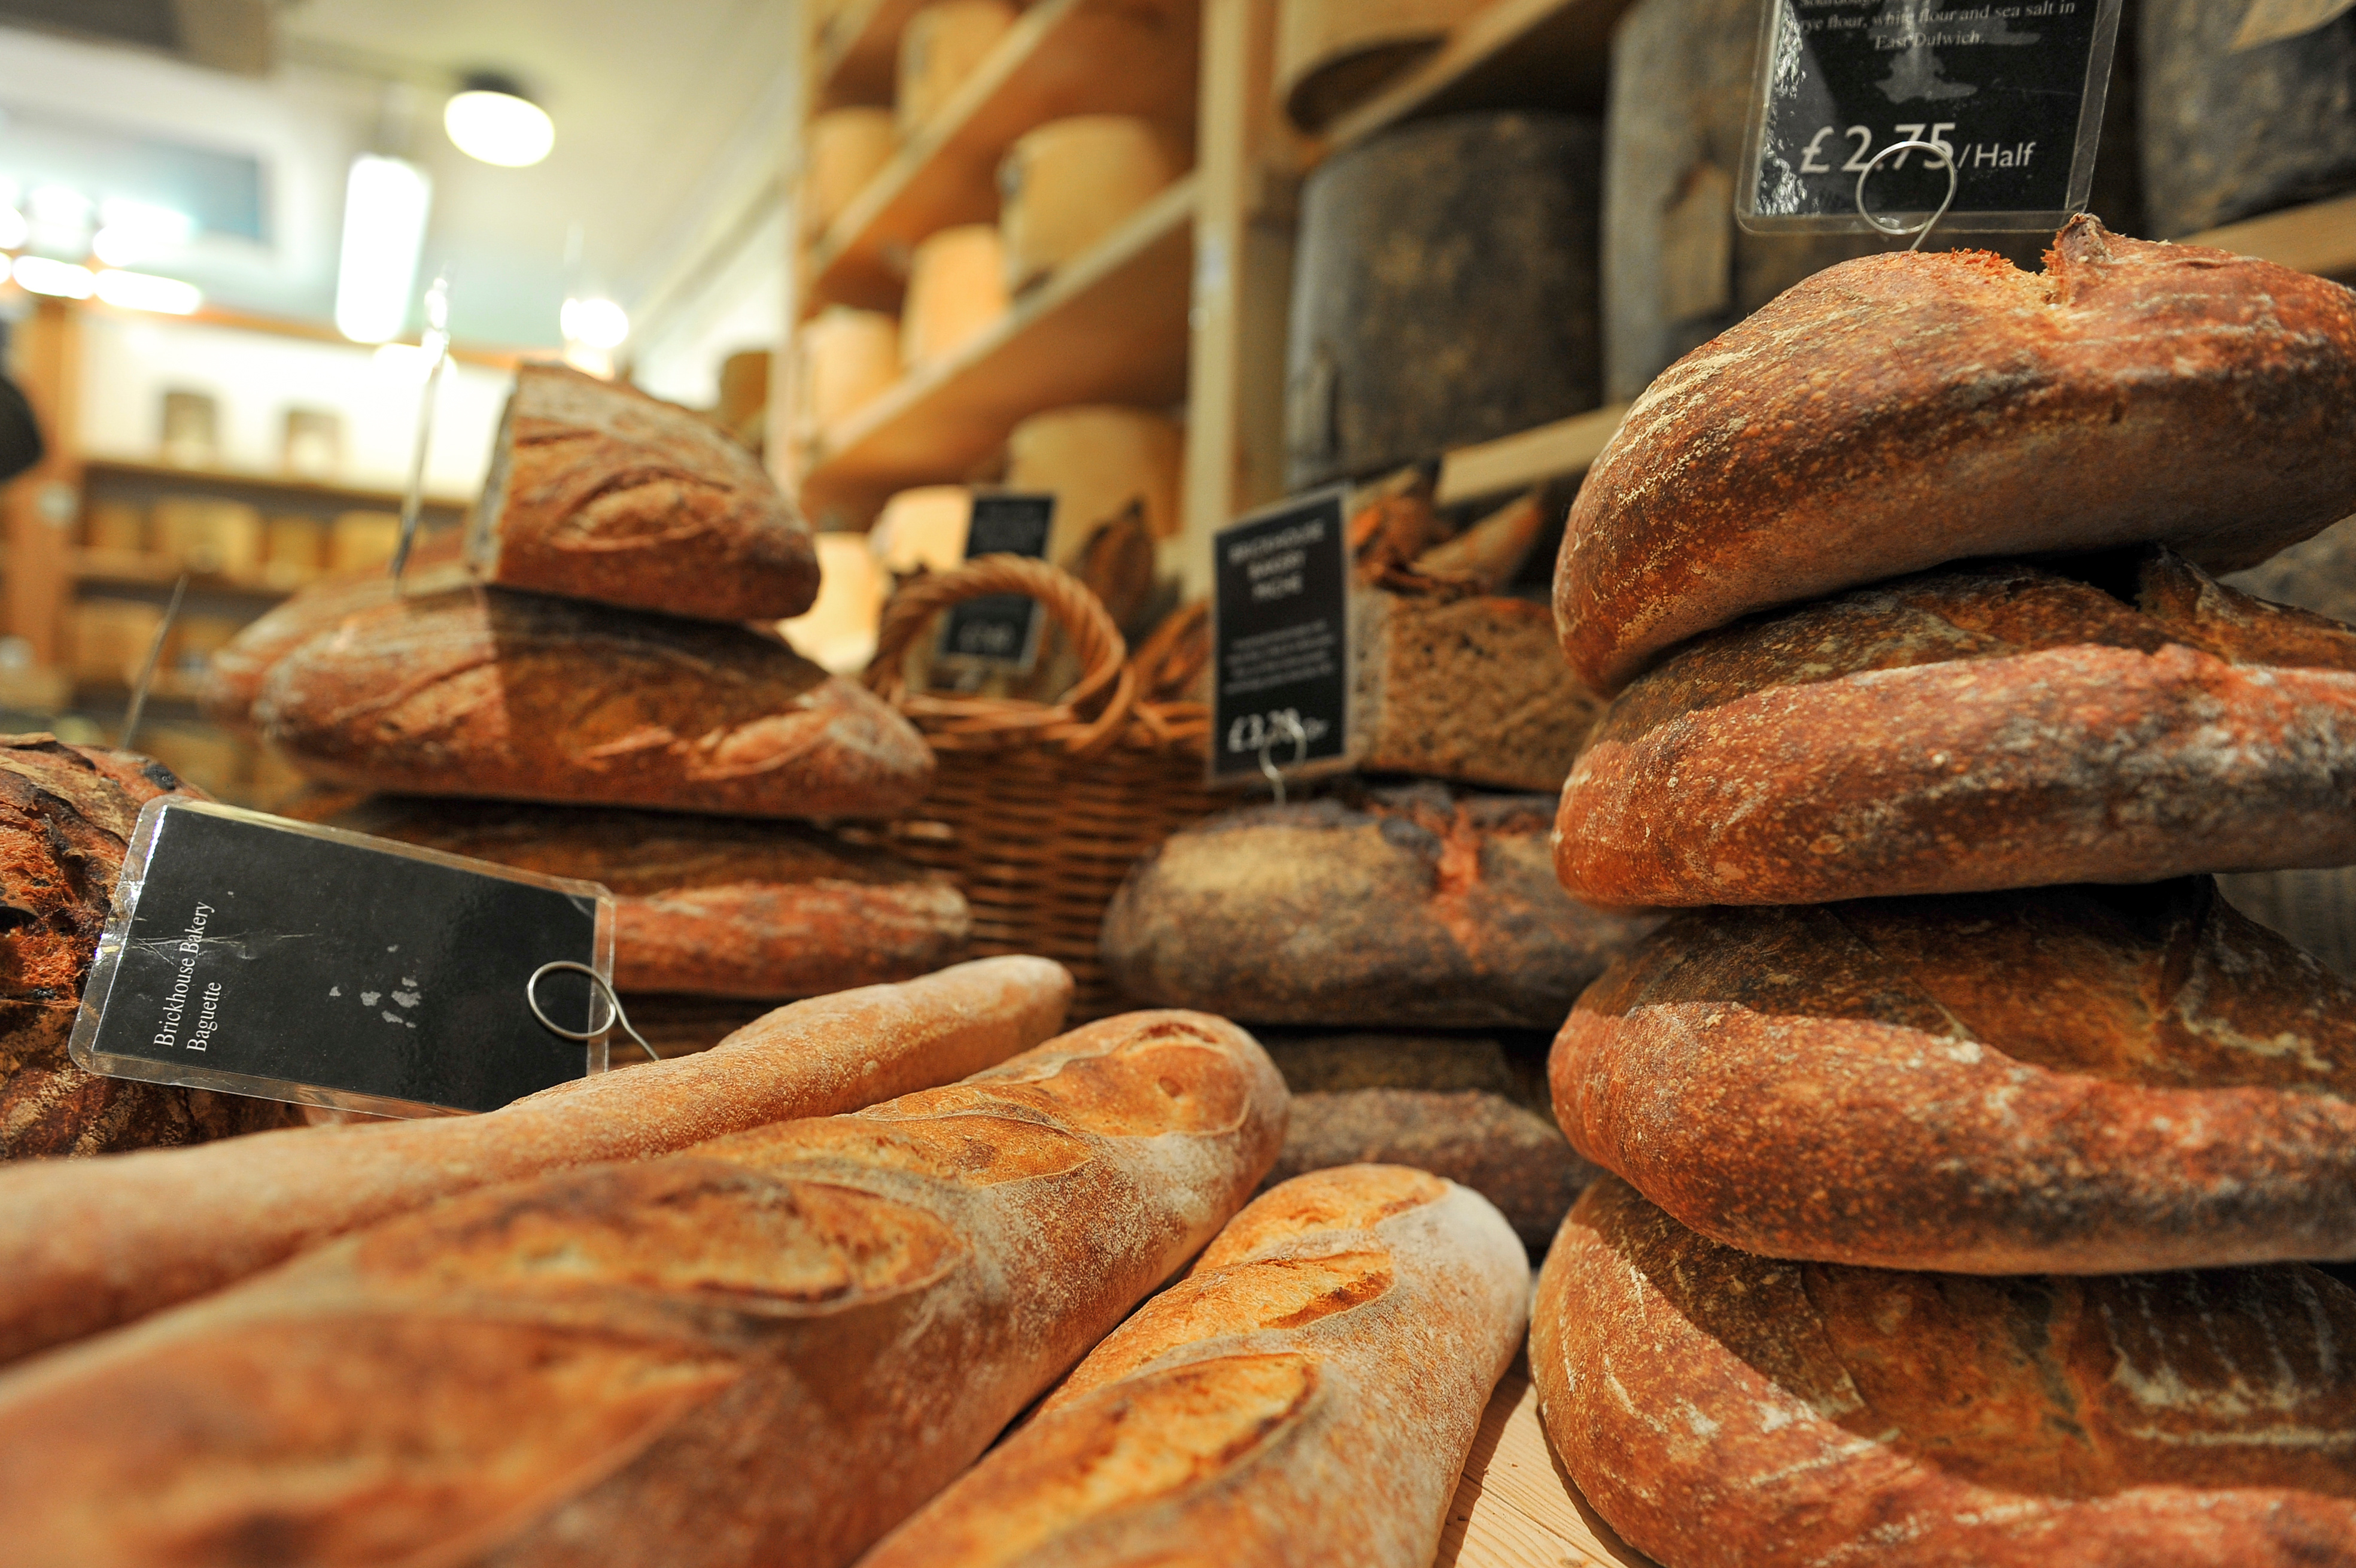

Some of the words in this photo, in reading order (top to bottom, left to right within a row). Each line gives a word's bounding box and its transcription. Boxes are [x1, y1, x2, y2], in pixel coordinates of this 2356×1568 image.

[1826, 14, 1868, 29] flour,
[1919, 8, 1957, 23] flour
[1960, 5, 1990, 21] and
[1995, 6, 2020, 18] sea
[2026, 1, 2053, 16] salt
[2059, 1, 2075, 14] in
[1874, 34, 1911, 50] East
[1912, 30, 1984, 48] Dulwich.
[153, 958, 196, 1047] Brickhouse
[179, 901, 215, 955] Bakery
[186, 981, 221, 1052] Baguette
